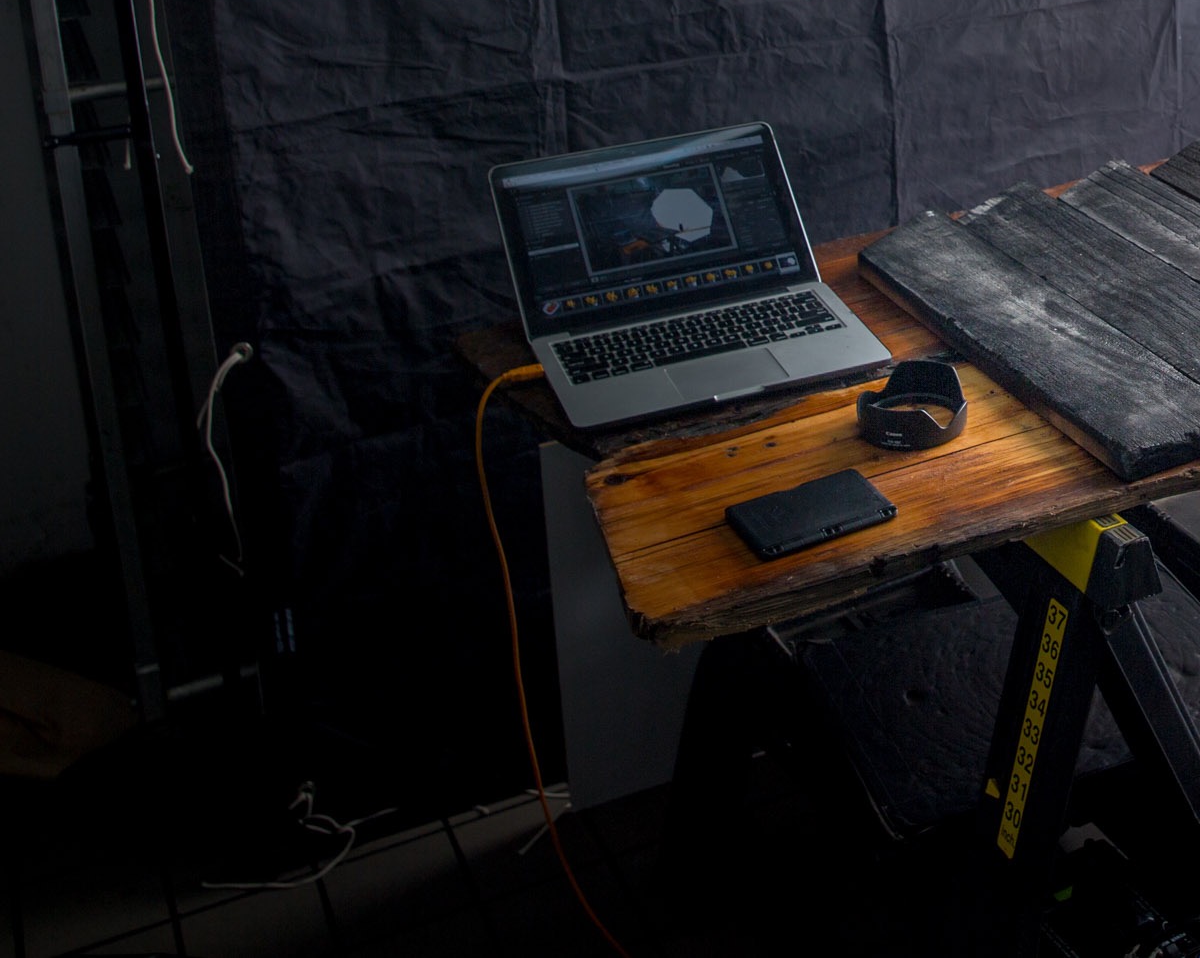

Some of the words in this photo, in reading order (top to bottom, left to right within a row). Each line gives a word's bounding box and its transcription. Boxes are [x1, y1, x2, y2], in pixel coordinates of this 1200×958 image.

[1048, 604, 1067, 630] 37
[1041, 633, 1059, 660] 36
[1035, 661, 1052, 689] 35
[1029, 690, 1046, 718] 34
[1023, 718, 1040, 746] 33
[1017, 746, 1034, 774] 32
[1011, 774, 1027, 802] 31
[1005, 801, 1021, 829] 30
